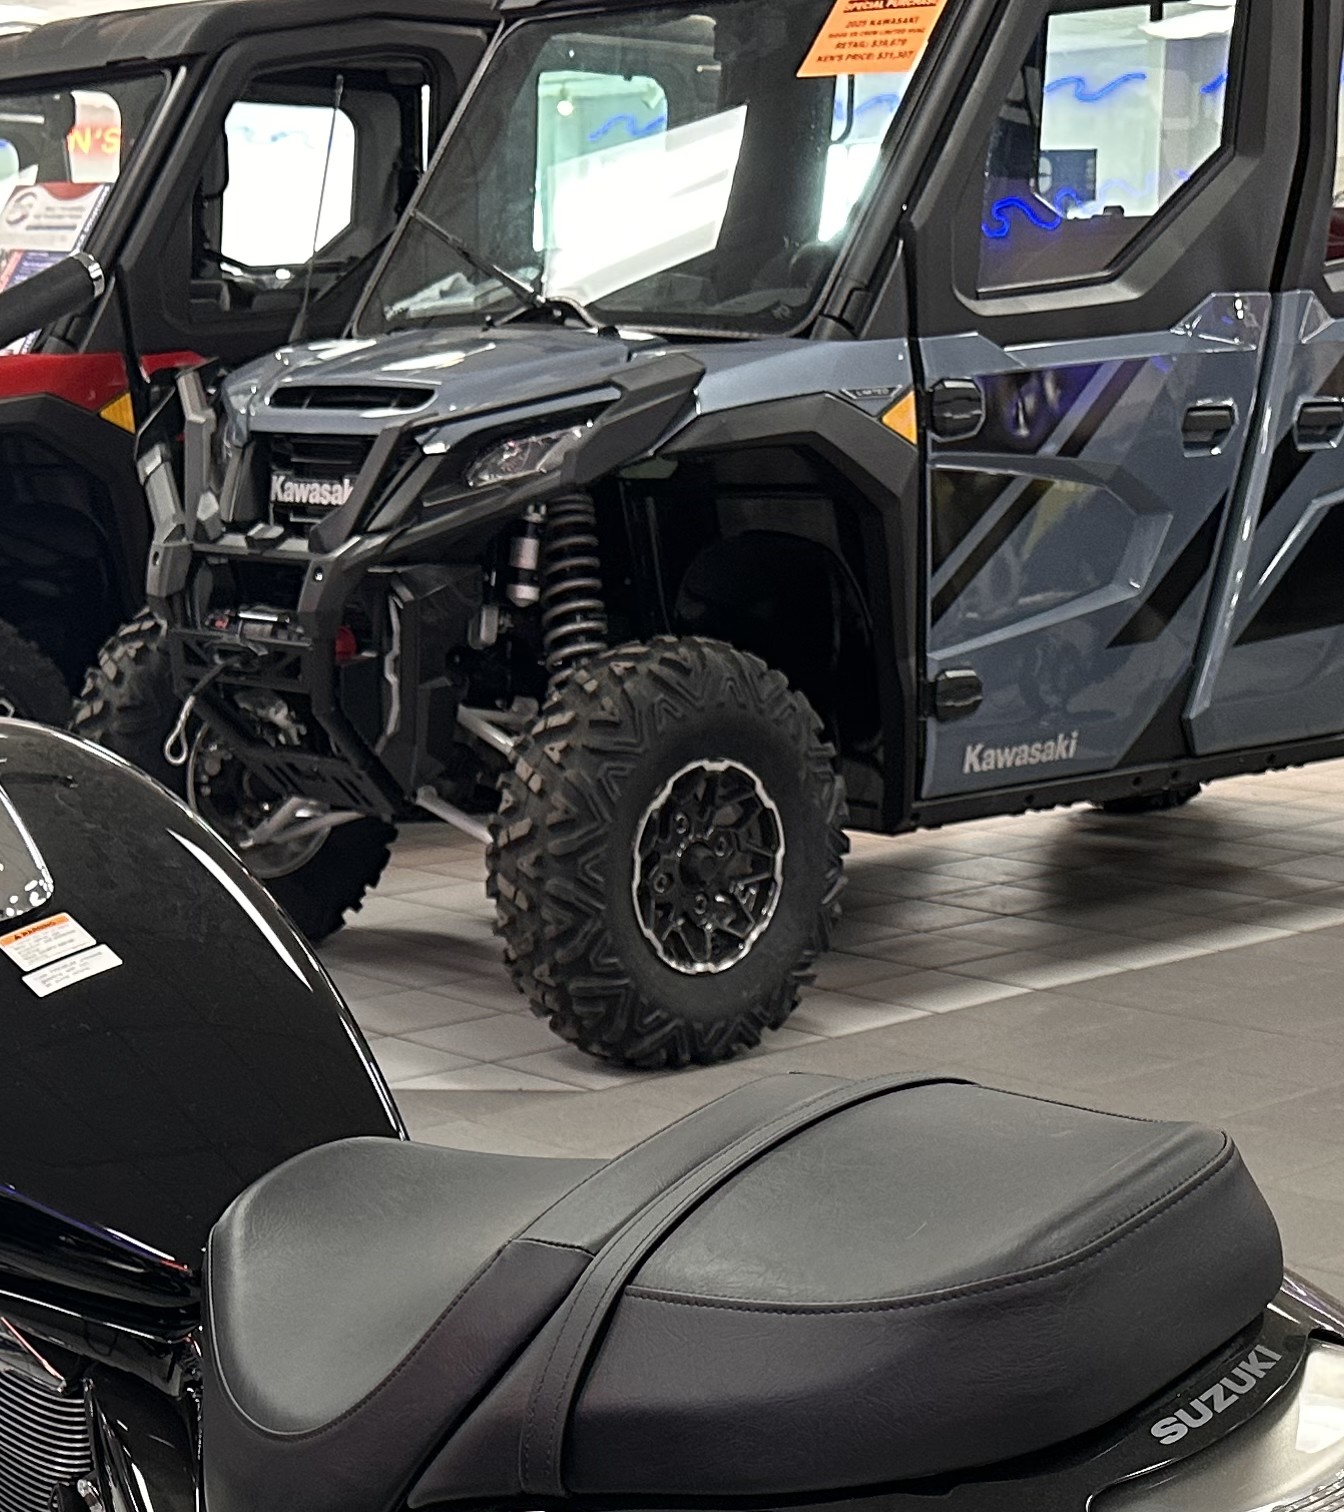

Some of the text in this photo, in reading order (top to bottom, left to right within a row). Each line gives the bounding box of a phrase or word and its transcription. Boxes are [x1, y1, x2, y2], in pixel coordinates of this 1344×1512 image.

[270, 475, 354, 506] Kawasak
[963, 729, 1079, 774] Kawasaki
[1150, 1344, 1282, 1445] SUZUKI
